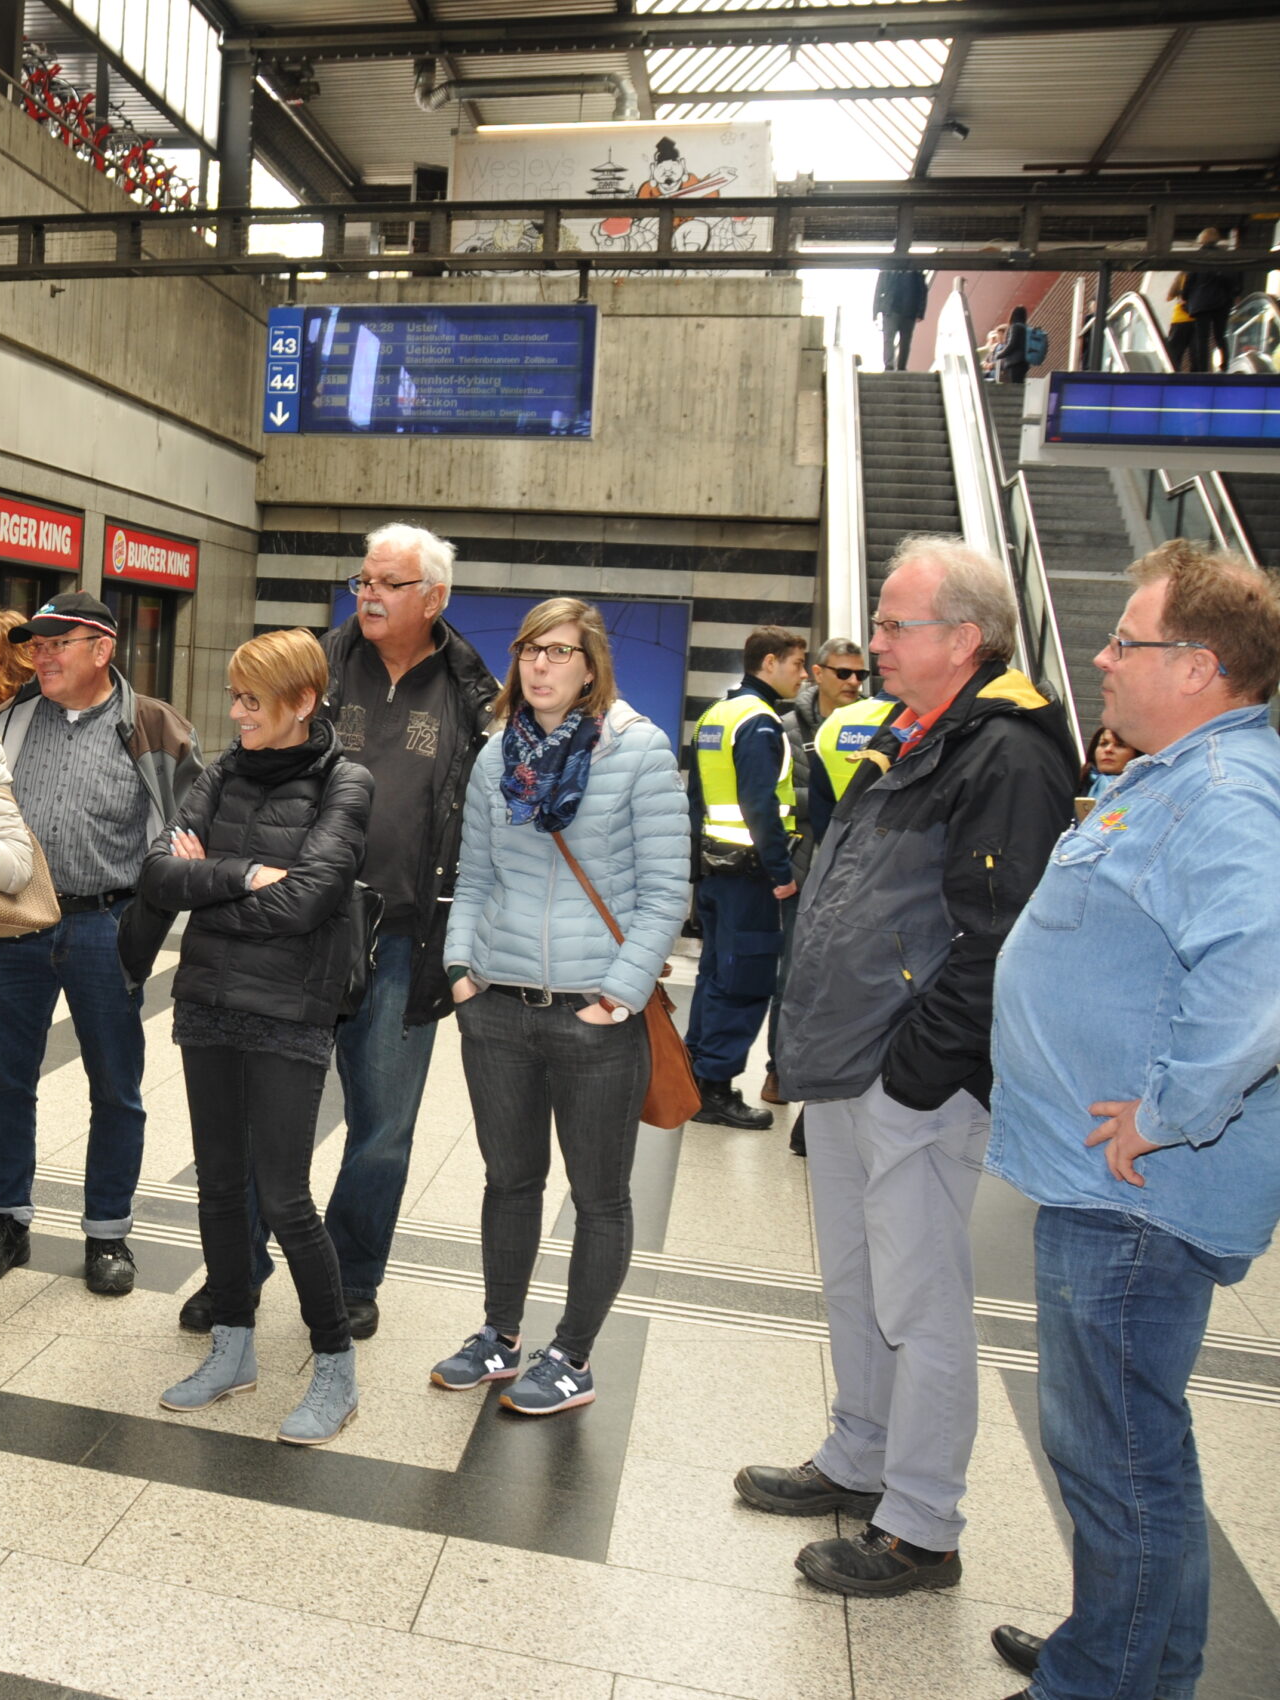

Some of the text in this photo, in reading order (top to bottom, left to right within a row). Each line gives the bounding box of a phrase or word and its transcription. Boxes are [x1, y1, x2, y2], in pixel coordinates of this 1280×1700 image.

[464, 152, 575, 181] Wesley's
[407, 323, 438, 332] Uster
[272, 338, 297, 354] 43
[270, 374, 295, 390] 44
[38, 520, 72, 555] KING
[127, 541, 167, 574] BURGER
[167, 550, 190, 578] KING
[405, 725, 437, 754] 72
[839, 730, 872, 745] Siche
